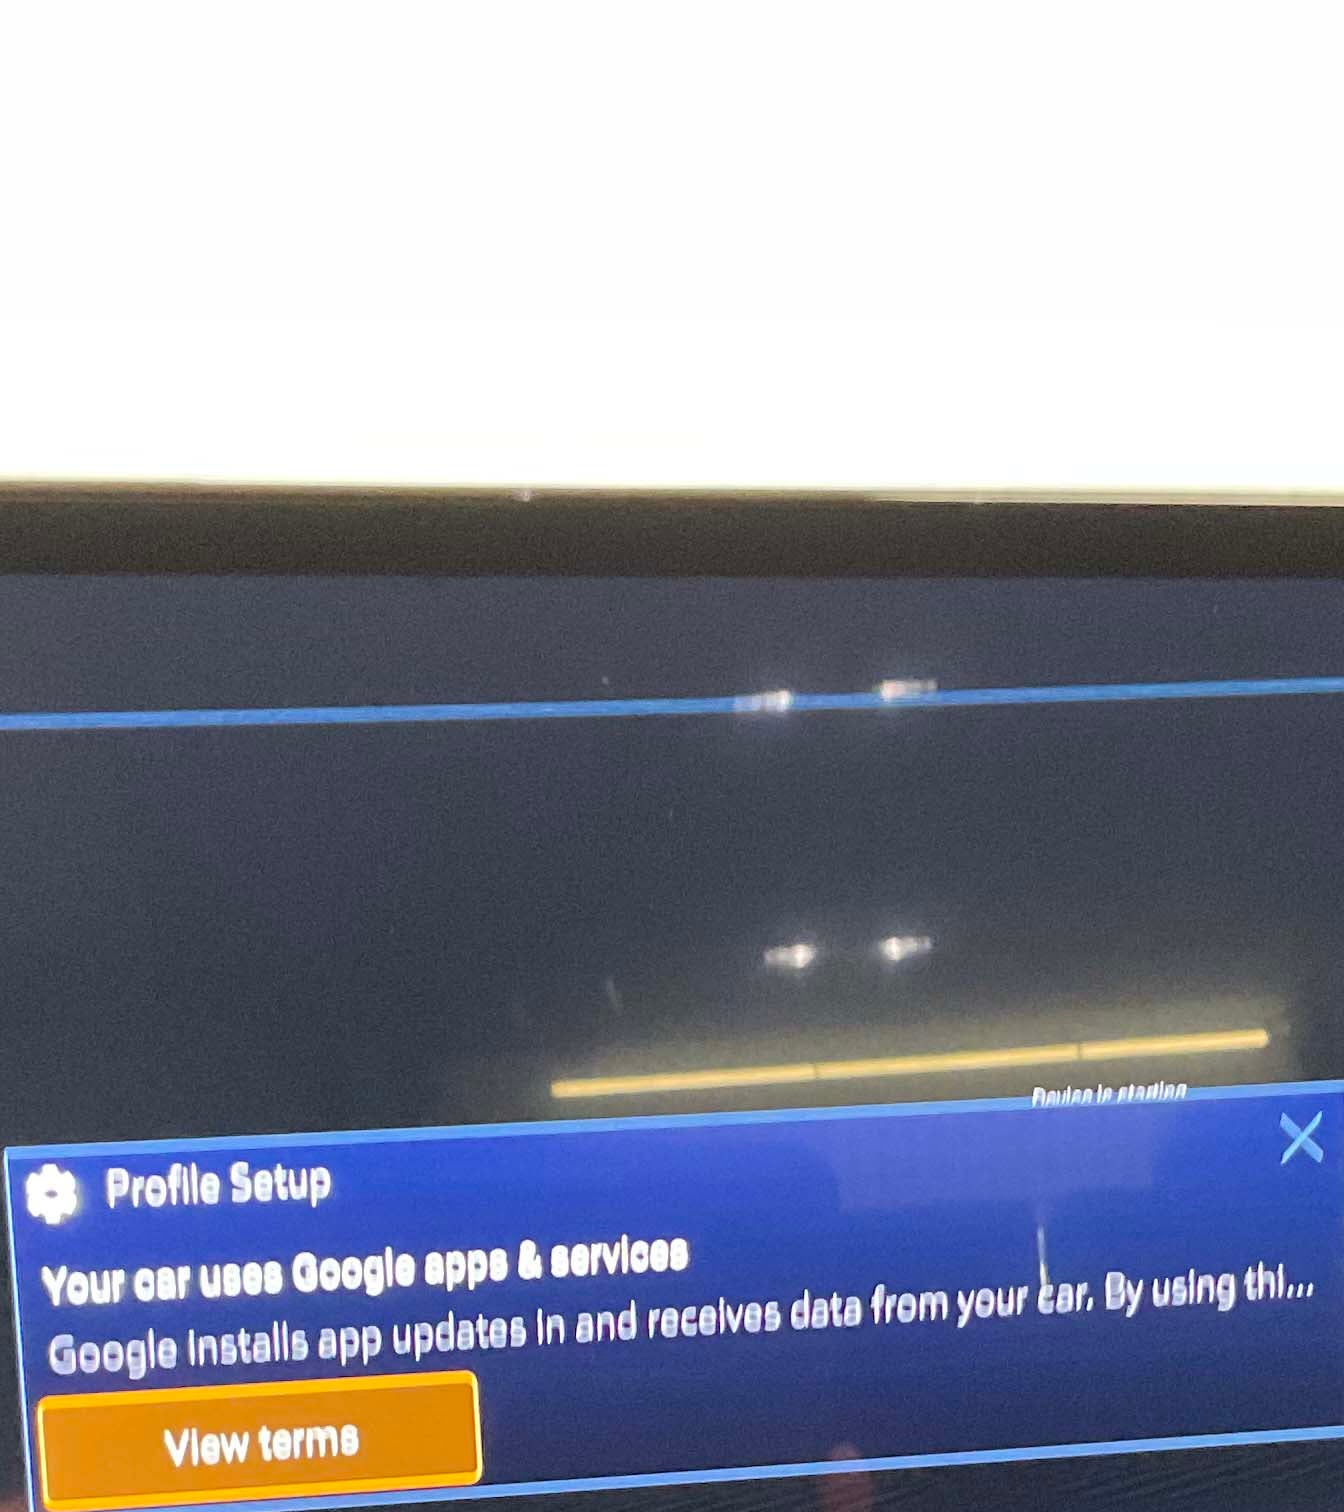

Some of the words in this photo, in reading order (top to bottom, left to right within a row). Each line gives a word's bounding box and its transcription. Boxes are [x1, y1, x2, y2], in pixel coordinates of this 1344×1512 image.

[106, 1161, 221, 1209] Profile
[230, 1160, 332, 1209] Setup
[41, 1264, 126, 1307] Your
[134, 1265, 192, 1302] car
[199, 1260, 284, 1298] uses
[292, 1246, 416, 1297] Google
[424, 1246, 509, 1292] apps
[517, 1239, 543, 1281] &
[550, 1233, 689, 1279] services
[48, 1327, 178, 1381] Google
[187, 1319, 309, 1367] installs
[317, 1324, 383, 1367] app
[392, 1310, 527, 1362] updates
[536, 1308, 565, 1346] in
[575, 1299, 637, 1344] and
[648, 1296, 781, 1339] receives
[790, 1289, 862, 1331] data
[870, 1283, 949, 1325] from
[956, 1283, 1029, 1329] your
[1037, 1281, 1094, 1314] car.
[1104, 1270, 1144, 1318] By
[1152, 1268, 1236, 1312] using
[162, 1428, 249, 1468] View
[257, 1422, 360, 1461] terms
